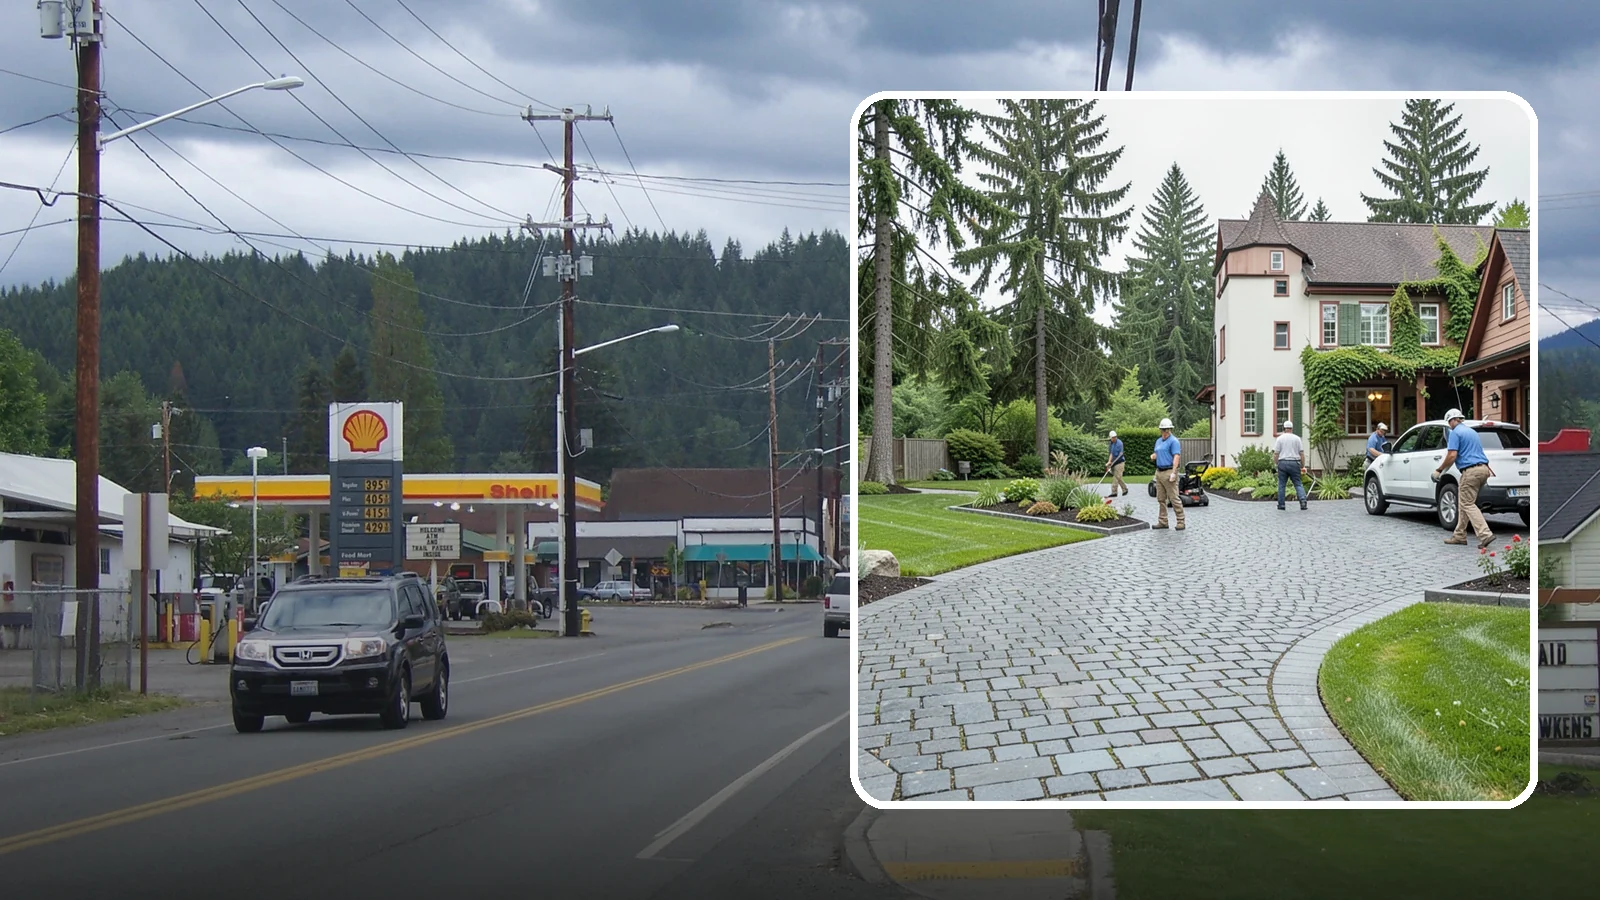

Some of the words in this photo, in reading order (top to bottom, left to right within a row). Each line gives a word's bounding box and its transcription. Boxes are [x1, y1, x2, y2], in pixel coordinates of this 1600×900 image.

[366, 480, 383, 490] 395
[490, 484, 547, 499] Shell
[366, 494, 383, 504] 405
[366, 508, 383, 518] 415
[366, 522, 383, 532] 429
